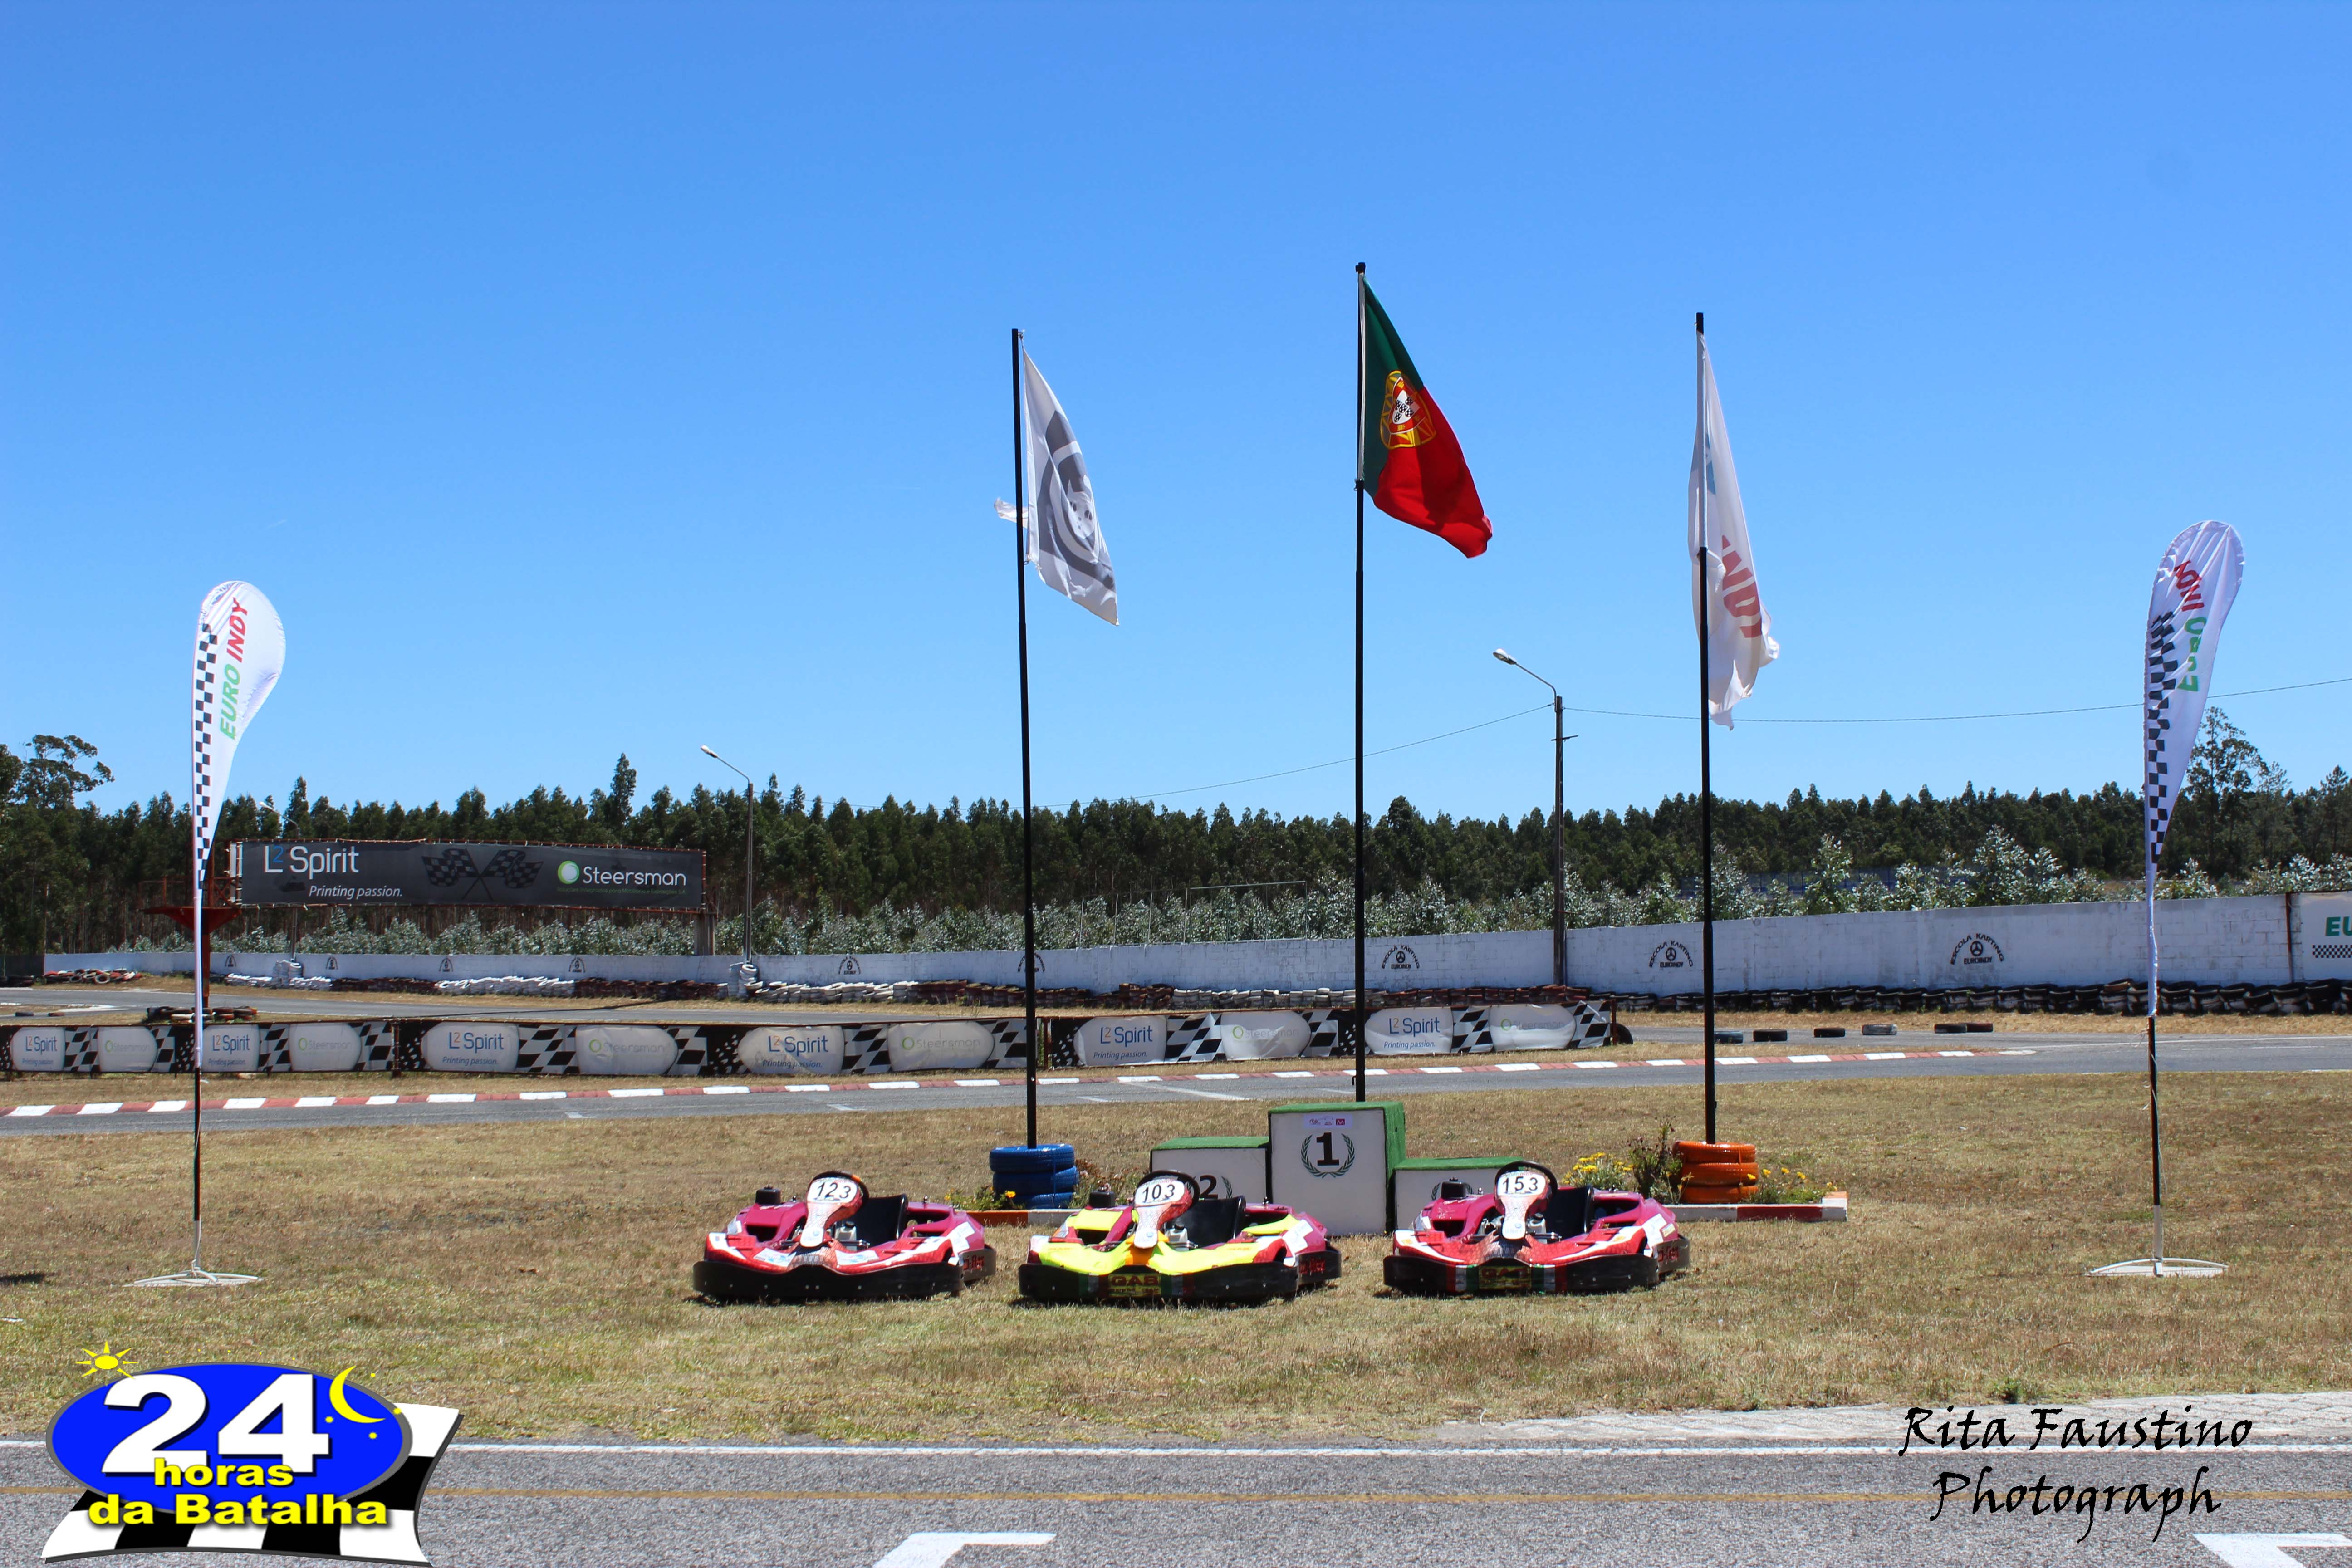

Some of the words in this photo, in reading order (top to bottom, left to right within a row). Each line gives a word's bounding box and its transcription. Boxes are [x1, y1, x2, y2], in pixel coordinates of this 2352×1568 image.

[227, 597, 248, 663] INDY
[220, 664, 240, 740] EURO
[290, 846, 359, 879] Spirit
[583, 866, 686, 886] Steersman
[309, 885, 354, 900] Printing
[357, 885, 402, 899] passion.
[1114, 1026, 1153, 1047] Spirit
[1403, 1017, 1440, 1037] Spirit
[34, 1036, 58, 1054] Spirit
[222, 1035, 250, 1054] Spirit
[464, 1032, 504, 1053] Spirit
[784, 1035, 828, 1056] Spirit
[1384, 1041, 1409, 1050] Printing
[1410, 1040, 1436, 1049] passion.
[442, 1056, 469, 1066] Printing
[763, 1059, 791, 1068] Printing
[1093, 1051, 1119, 1060] Printing
[1121, 1050, 1147, 1058] passion.
[1316, 1132, 1339, 1166] 1
[817, 1181, 851, 1199] 123
[1142, 1184, 1175, 1203] 103
[1200, 1175, 1218, 1199] 2
[1502, 1176, 1538, 1193] 153
